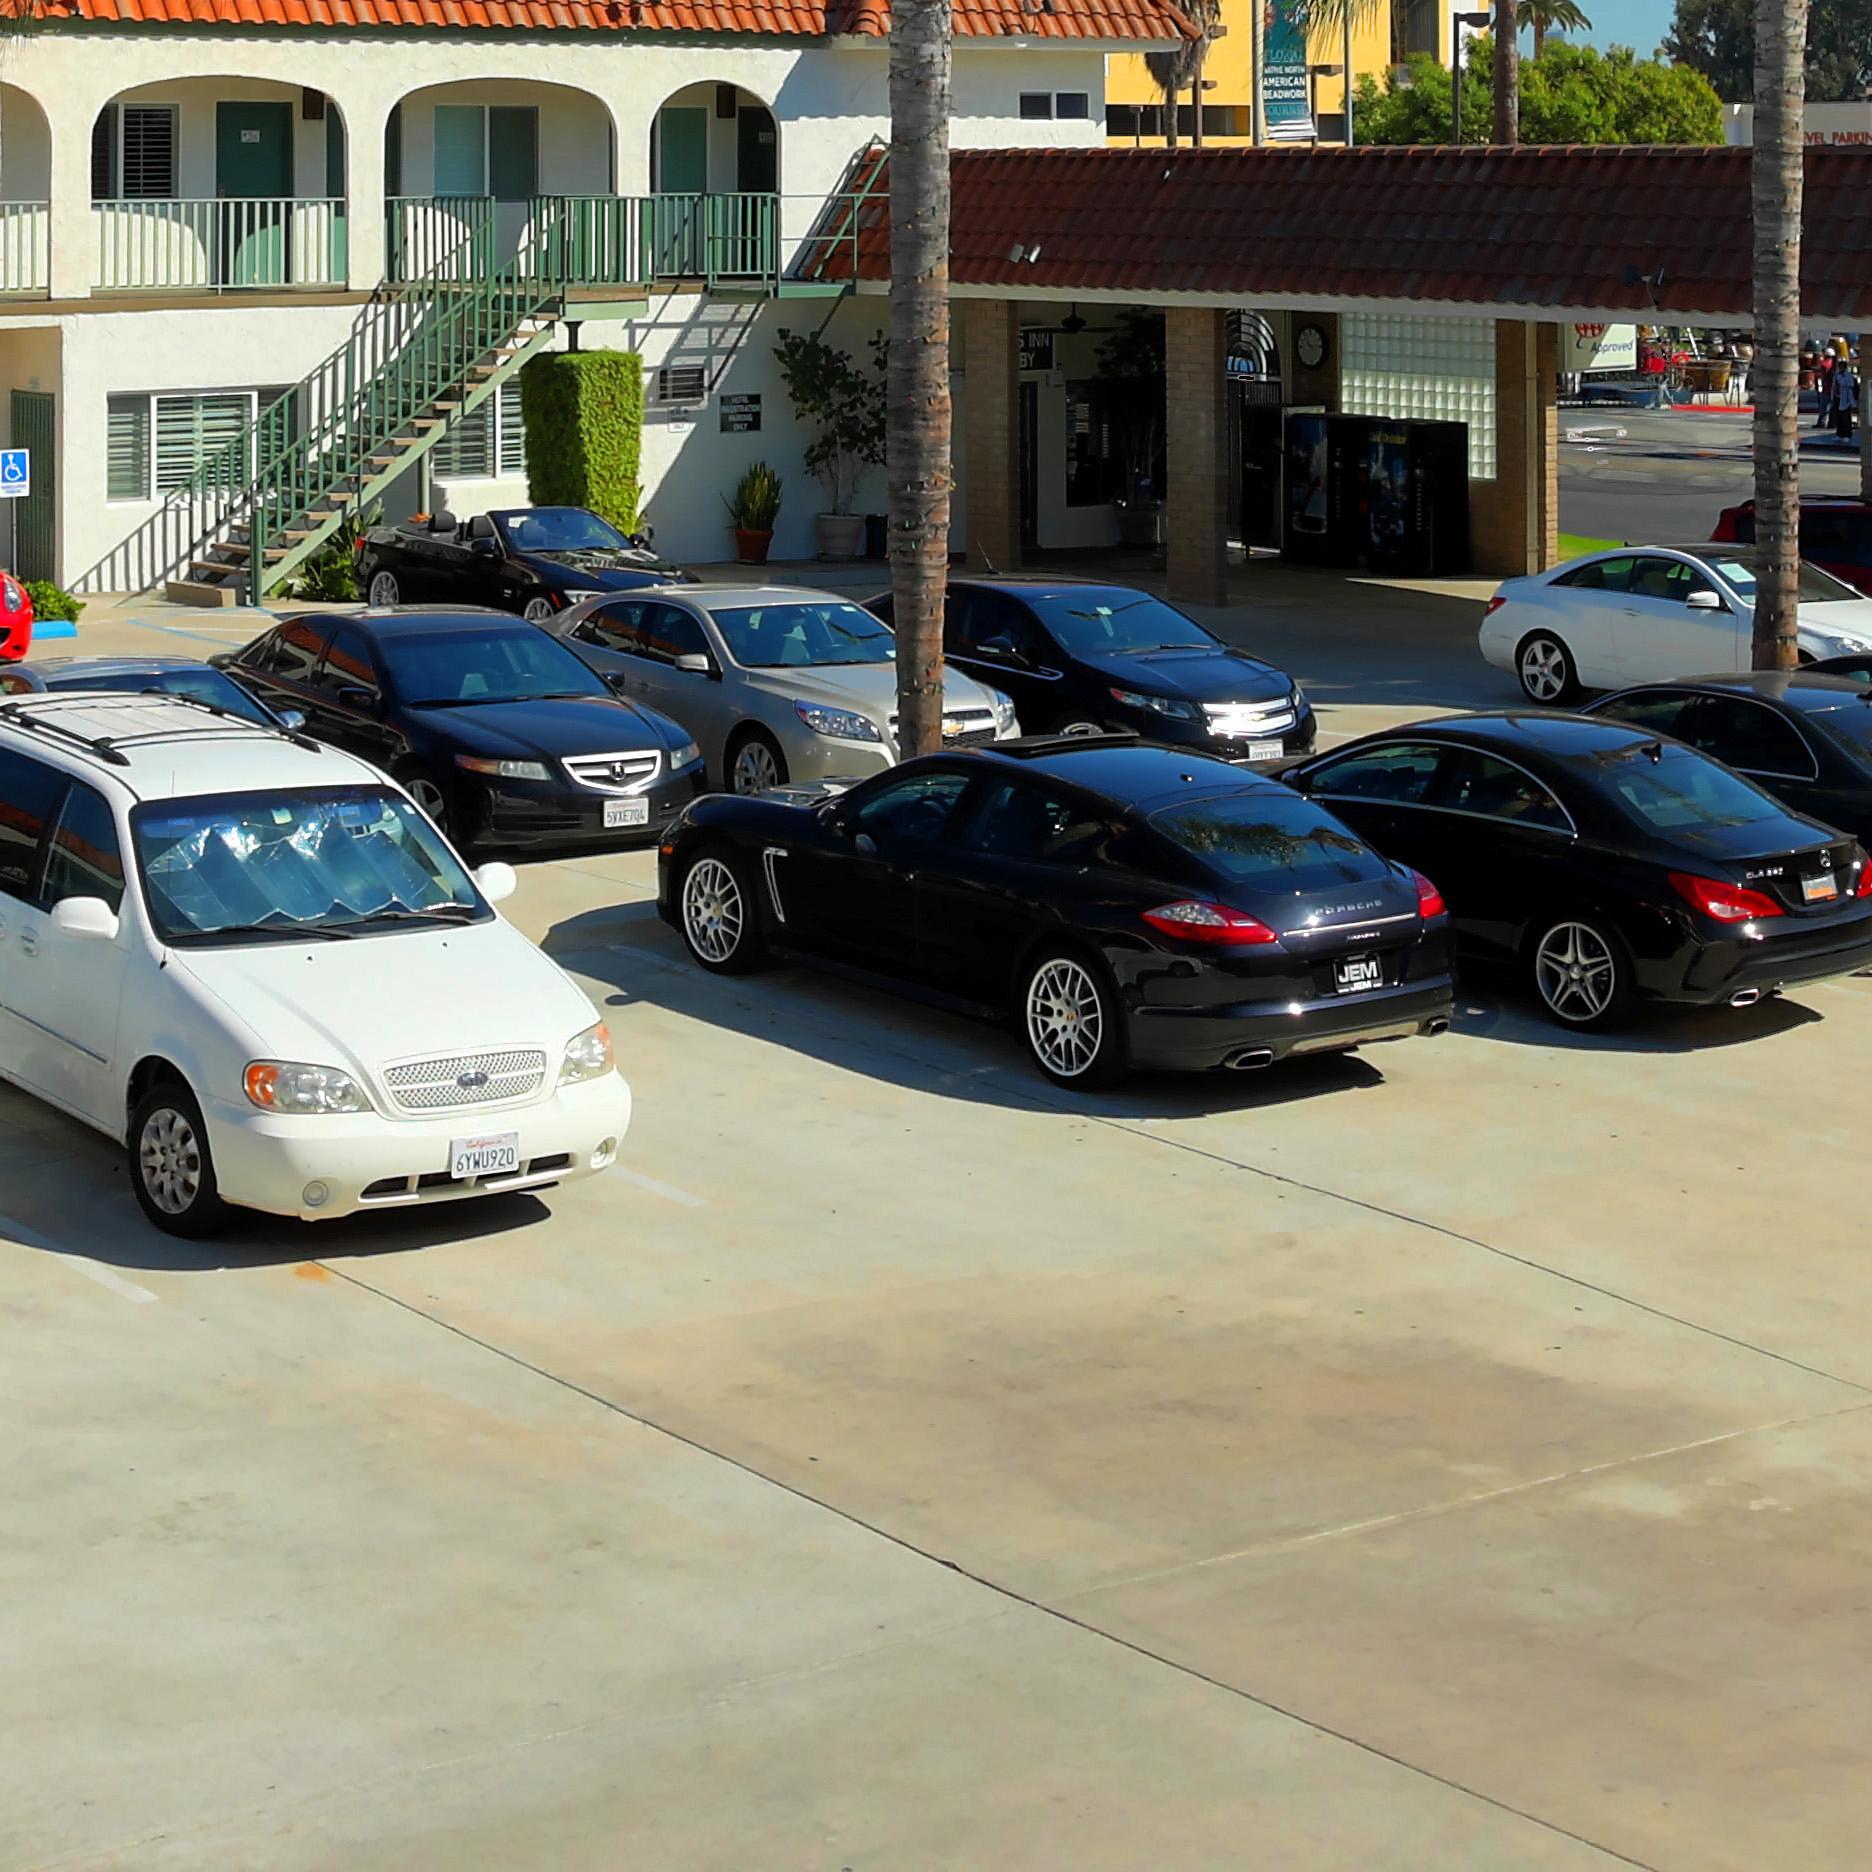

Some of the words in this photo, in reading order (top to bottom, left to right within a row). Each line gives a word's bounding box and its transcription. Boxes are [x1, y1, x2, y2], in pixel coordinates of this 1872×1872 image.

[1263, 76, 1306, 87] AMERICAN
[1263, 89, 1306, 100] BEADWORK
[1028, 331, 1049, 348] INN
[1591, 339, 1633, 354] Approved
[1338, 960, 1378, 983] JEM
[456, 1147, 515, 1173] 6YWU920
